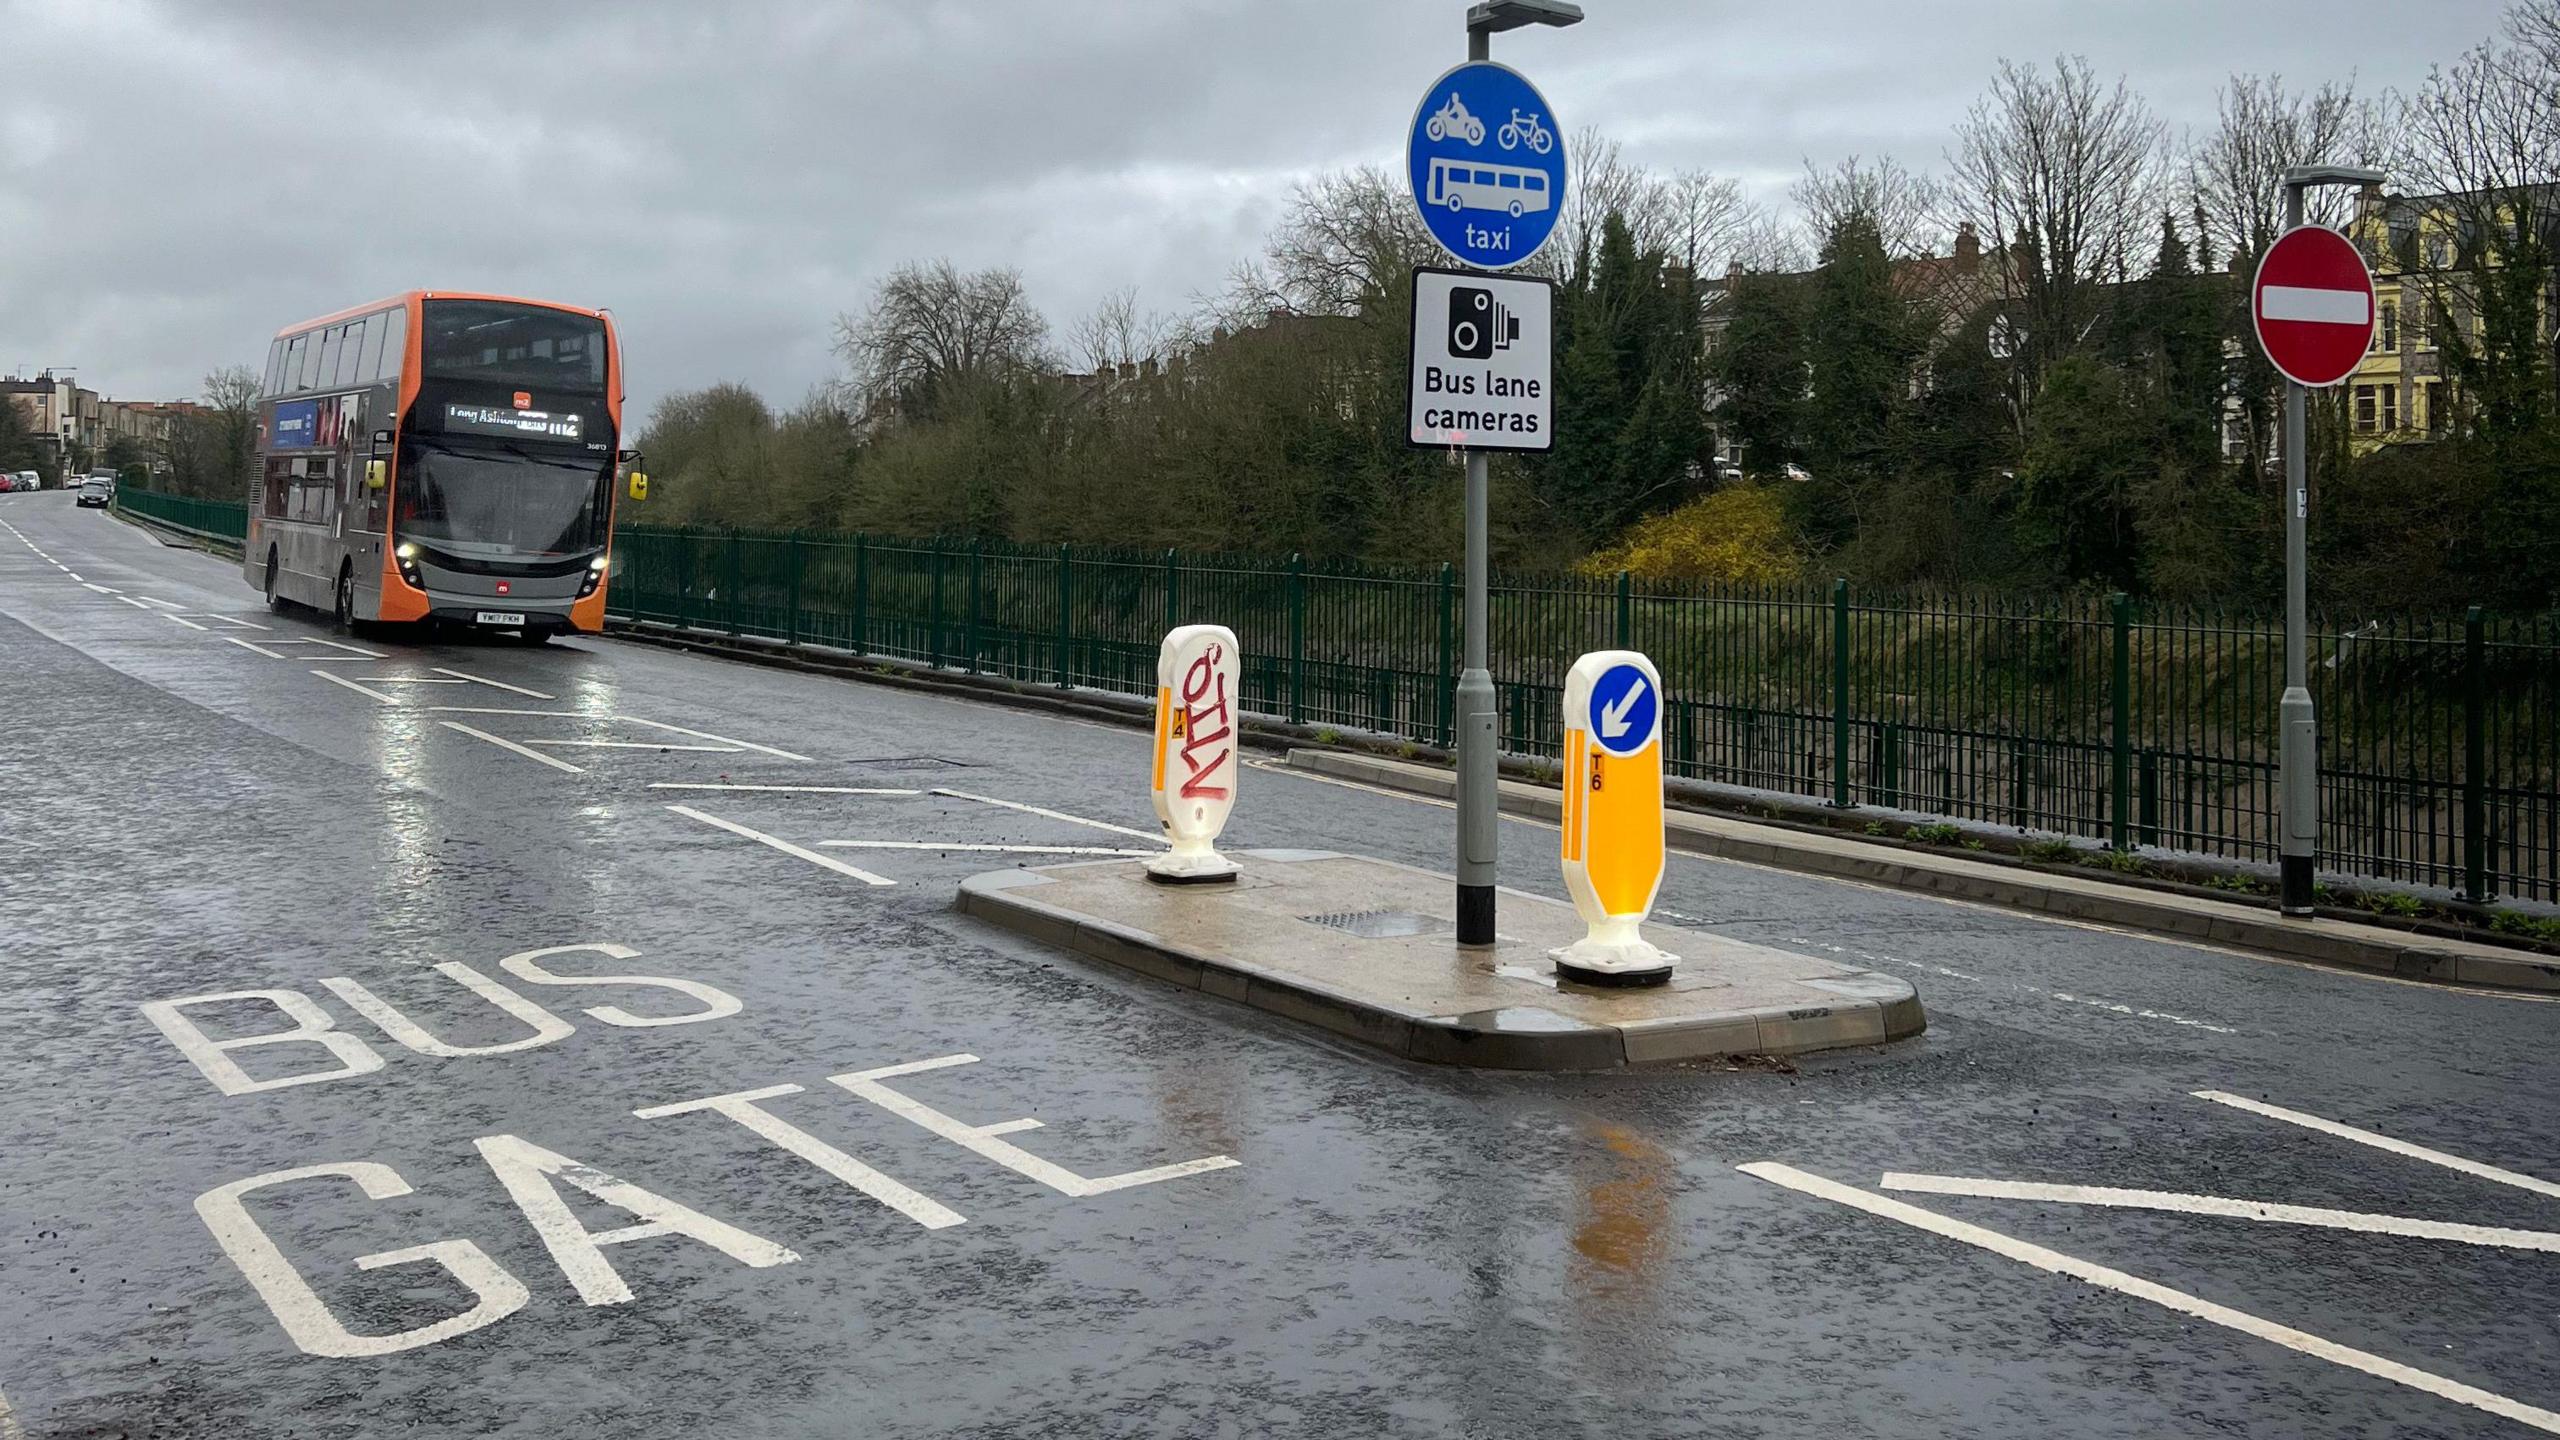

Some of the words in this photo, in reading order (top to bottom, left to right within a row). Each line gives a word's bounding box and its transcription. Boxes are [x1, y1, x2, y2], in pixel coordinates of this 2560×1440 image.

[1465, 222, 1511, 252] taxi
[1424, 366, 1475, 396] Bus
[1486, 369, 1541, 399] lane
[1423, 407, 1540, 434] cameras
[138, 942, 744, 1097] BUS
[192, 1053, 1243, 1358] GATE
